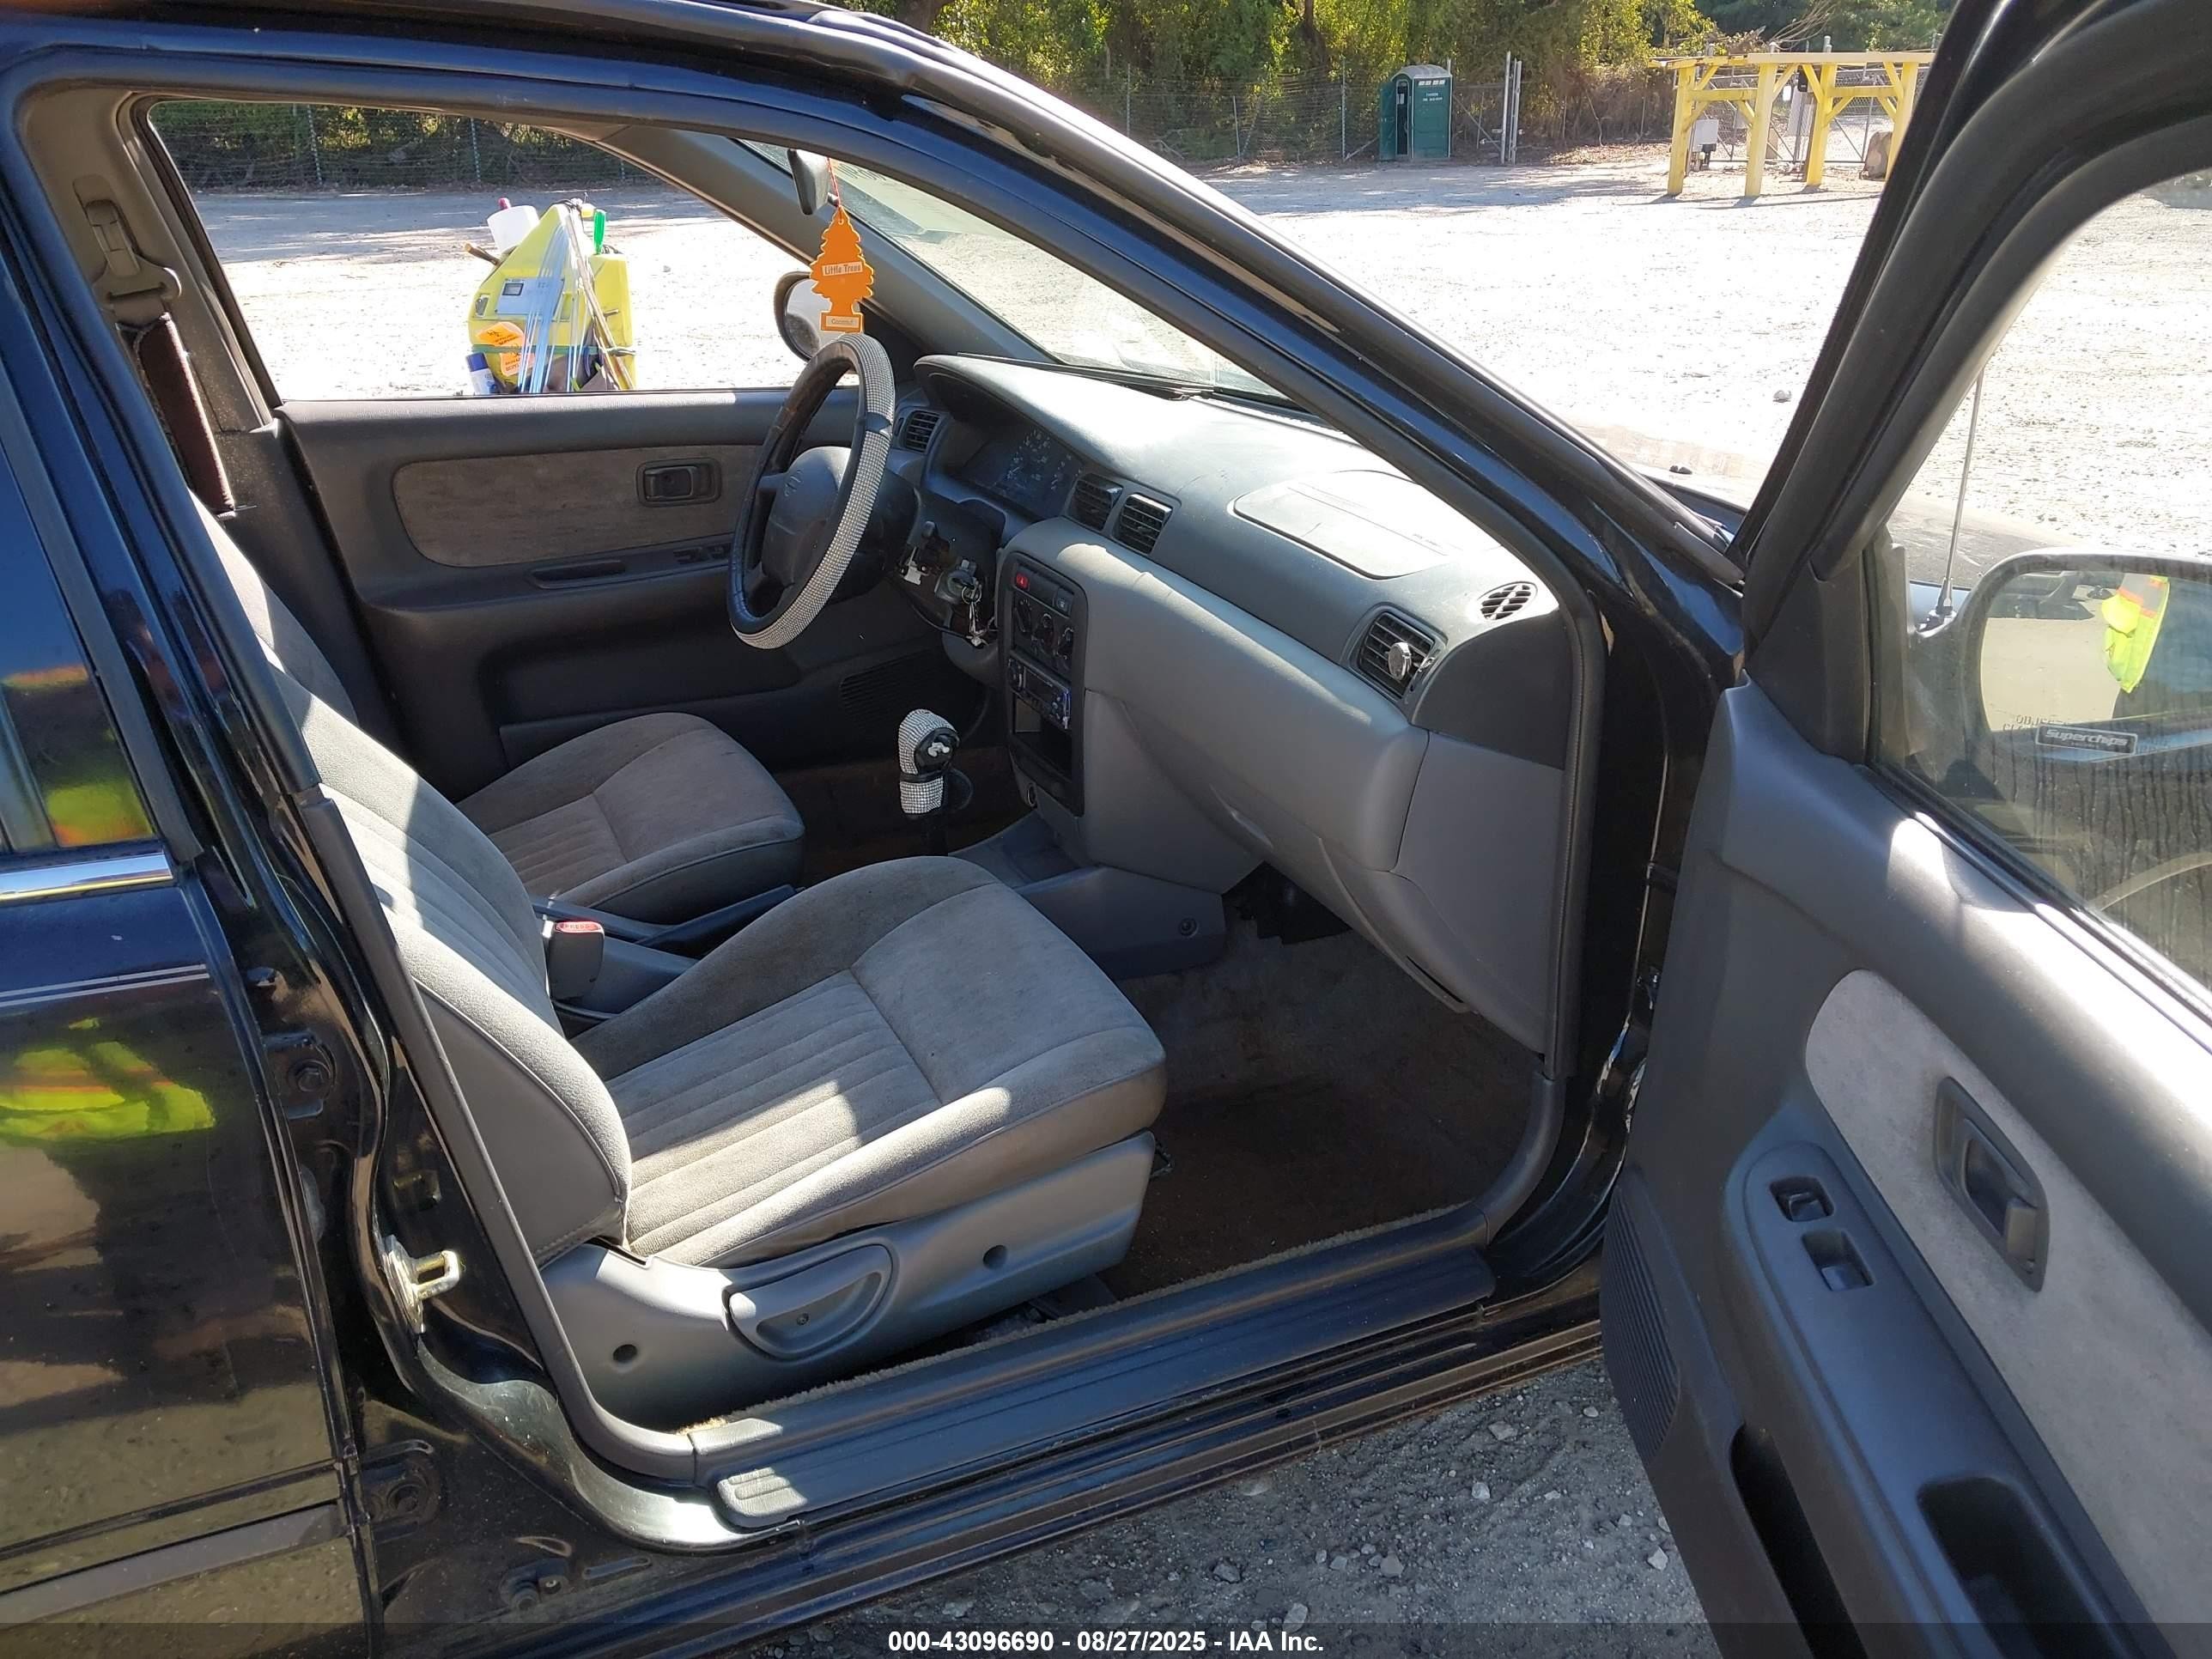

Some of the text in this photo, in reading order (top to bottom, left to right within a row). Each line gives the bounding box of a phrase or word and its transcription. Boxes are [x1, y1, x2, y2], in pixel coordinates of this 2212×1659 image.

[824, 264, 861, 275] Little Trees
[2045, 728, 2129, 747] Superchips
